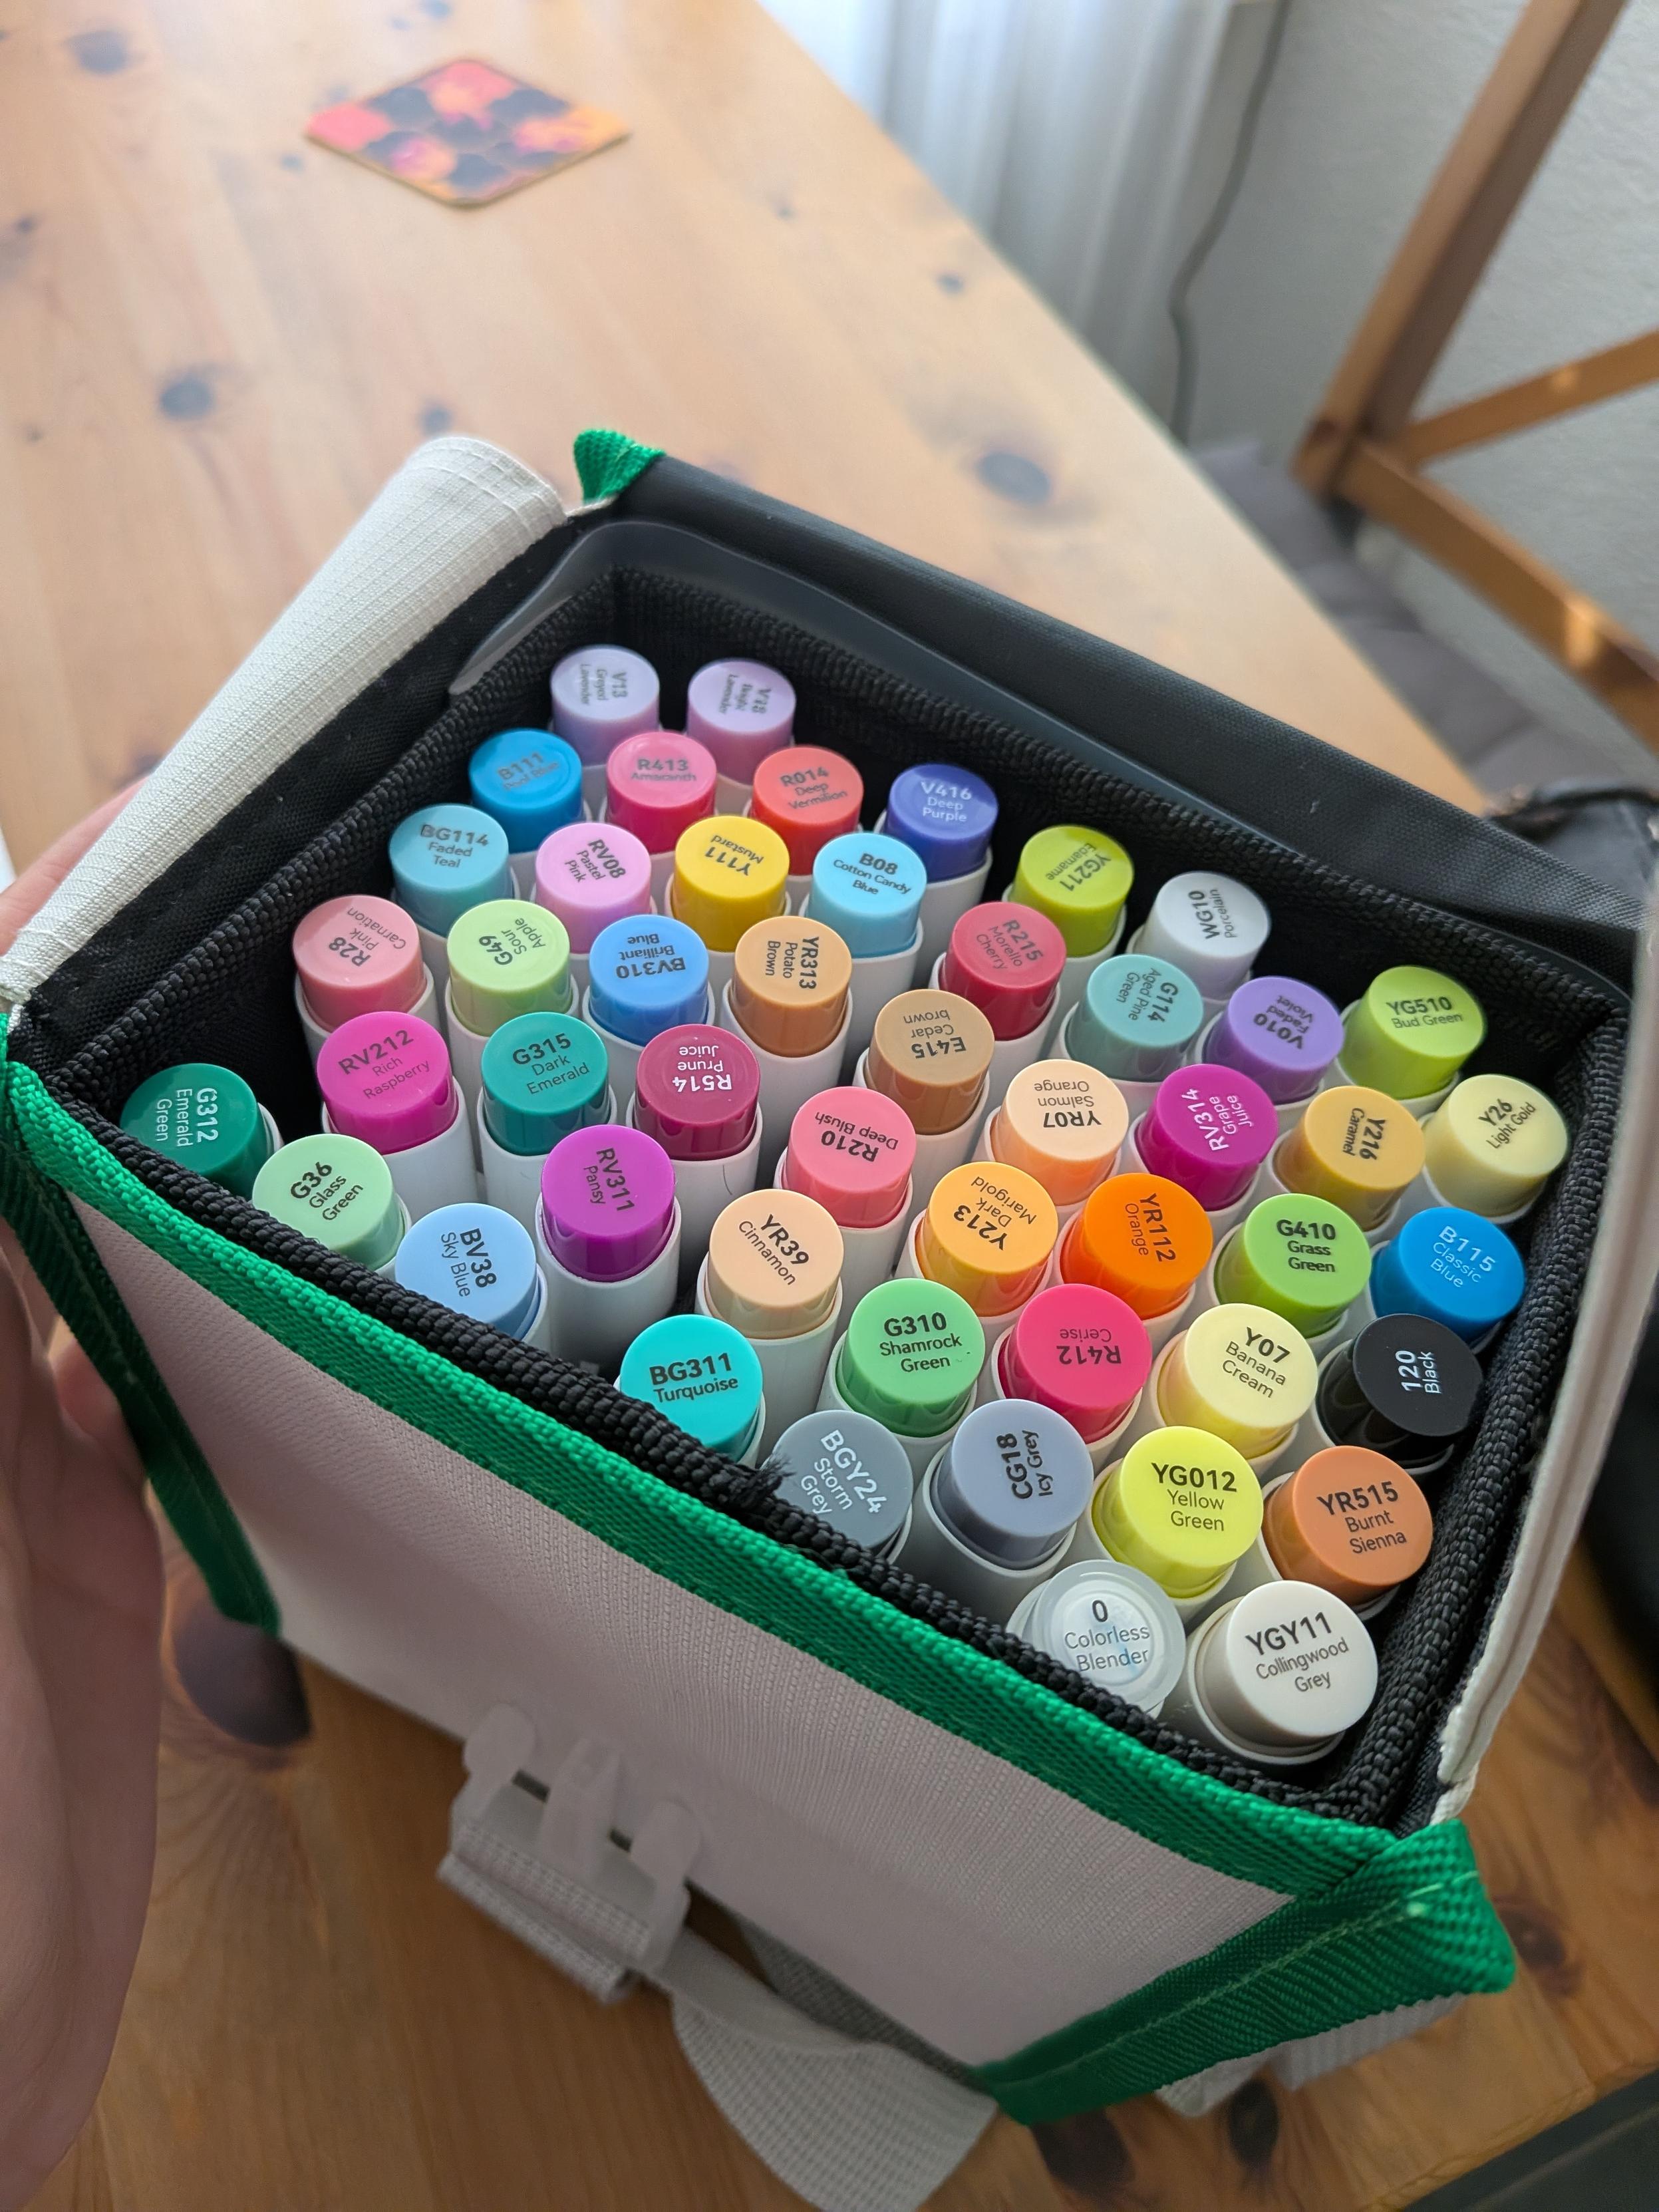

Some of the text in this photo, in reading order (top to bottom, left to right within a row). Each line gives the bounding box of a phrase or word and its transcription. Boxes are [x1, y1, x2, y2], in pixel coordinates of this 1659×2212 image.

[611, 672, 627, 698] V13
[496, 753, 543, 782] B111
[631, 772, 697, 782] Amaranth
[637, 760, 688, 771] R413
[780, 767, 829, 786] R014
[788, 790, 848, 809] Vermilion
[794, 783, 829, 796] Deep
[921, 781, 972, 800] V416
[927, 798, 963, 811] Deep
[923, 807, 968, 822] Purple
[420, 825, 489, 846] BG114
[428, 842, 472, 858] Faded
[710, 835, 764, 864] Mustard
[433, 855, 461, 868] Teal
[565, 860, 585, 883] Pink
[576, 850, 605, 881] Pastel
[588, 839, 626, 879] RV08
[704, 847, 750, 875] Y111
[859, 853, 898, 875] B08
[1046, 843, 1097, 881] Edamame
[1060, 854, 1112, 891] YG211
[833, 860, 911, 894] Cotton Candy
[852, 879, 879, 895] Blue
[347, 907, 406, 949] Carnation
[1188, 890, 1220, 940] WG10
[1210, 889, 1237, 938] Porcelain
[350, 927, 377, 950] Pink
[502, 930, 527, 955] Sour
[515, 918, 546, 949] Apple
[627, 933, 659, 945] Blue
[988, 926, 1023, 967] Morello
[1002, 919, 1043, 962] R215
[329, 937, 371, 967] R28
[479, 935, 513, 965] G49
[619, 945, 675, 959] Brilliant
[765, 941, 781, 976] Brown
[783, 942, 798, 978] Potato
[800, 937, 820, 989] YR313
[977, 934, 1008, 970] Cherry
[616, 957, 686, 979] BV310
[1116, 972, 1138, 1003] Green
[1128, 968, 1162, 1021] Aged Pine
[1147, 981, 1179, 1022] G114
[1266, 1005, 1310, 1034] Faded
[1277, 995, 1314, 1023] Violet
[1386, 997, 1452, 1015] YG510
[1392, 1013, 1464, 1029] Bud Green
[911, 1025, 955, 1039] Cedar
[1253, 1013, 1304, 1050] V010
[338, 1029, 414, 1075] RV212
[512, 1032, 572, 1064] G315
[679, 1045, 718, 1057] Juice
[911, 1036, 966, 1059] E415
[363, 1060, 431, 1100] Raspberry
[372, 1056, 402, 1077] Rich
[526, 1063, 591, 1095] Emerald
[531, 1054, 570, 1076] Dark
[677, 1060, 723, 1073] Prune
[672, 1074, 732, 1092] R514
[1034, 1081, 1090, 1093] Orange
[197, 1088, 218, 1143] G312
[1038, 1095, 1094, 1107] Salmon
[1210, 1096, 1237, 1135] Grape
[1227, 1095, 1255, 1127] Juice
[1478, 1098, 1513, 1127] Y26
[156, 1098, 172, 1142] Green
[176, 1088, 194, 1147] Emerald
[815, 1112, 898, 1150] Deep Blush
[1042, 1110, 1102, 1128] YR07
[1181, 1088, 1229, 1151] RV314
[1342, 1108, 1365, 1156] Caramel
[1486, 1102, 1537, 1149] Light Gold
[822, 1131, 879, 1162] R210
[1360, 1118, 1386, 1161] Y216
[290, 1162, 332, 1199] G36
[309, 1176, 347, 1208] Glass
[583, 1165, 606, 1205] Pansy
[596, 1148, 635, 1212] RV311
[322, 1184, 363, 1220] Green
[971, 1176, 1036, 1225] Marigold
[976, 1197, 1012, 1227] Dark
[760, 1214, 809, 1265] YR39
[953, 1205, 1007, 1251] Y213
[1125, 1203, 1149, 1256] Orange
[1140, 1193, 1176, 1263] YR112
[1277, 1219, 1336, 1241] G410
[460, 1228, 497, 1287] BV38
[738, 1221, 796, 1286] Cinnamon
[1288, 1240, 1331, 1256] Grass
[1433, 1243, 1481, 1283] Classic
[1439, 1226, 1496, 1272] B115
[441, 1232, 470, 1297] Sky Blue
[1288, 1257, 1336, 1273] Green
[1431, 1257, 1463, 1288] Blue
[884, 1313, 947, 1337] G310
[1060, 1329, 1111, 1342] Cerise
[879, 1333, 963, 1356] Shamrock
[1056, 1345, 1122, 1364] R412
[1245, 1327, 1290, 1363] Y07
[649, 1353, 732, 1385] BG311
[901, 1356, 951, 1372] Green
[1223, 1360, 1274, 1398] Cream
[1225, 1341, 1286, 1386] Banana
[1395, 1350, 1422, 1392] 120
[1417, 1352, 1441, 1394] Black
[653, 1378, 738, 1403] Turquoise
[820, 1430, 887, 1513] BGY24
[996, 1433, 1032, 1500] CG18
[1022, 1430, 1054, 1496] Icy Grey
[1151, 1463, 1237, 1492] YG012
[800, 1475, 832, 1515] Grey
[814, 1458, 853, 1509] Storm
[1167, 1489, 1224, 1509] Yellow
[1317, 1481, 1399, 1515] YR515
[1171, 1511, 1224, 1531] Green
[1345, 1510, 1395, 1533] Burnt
[1350, 1530, 1407, 1554] Sienna
[1092, 1600, 1108, 1623] 0
[1064, 1625, 1149, 1650] Colorless
[1245, 1611, 1332, 1656] YGY11
[1076, 1650, 1149, 1672] Blender
[1256, 1637, 1350, 1680] Collingwood
[1294, 1672, 1332, 1692] Grey
